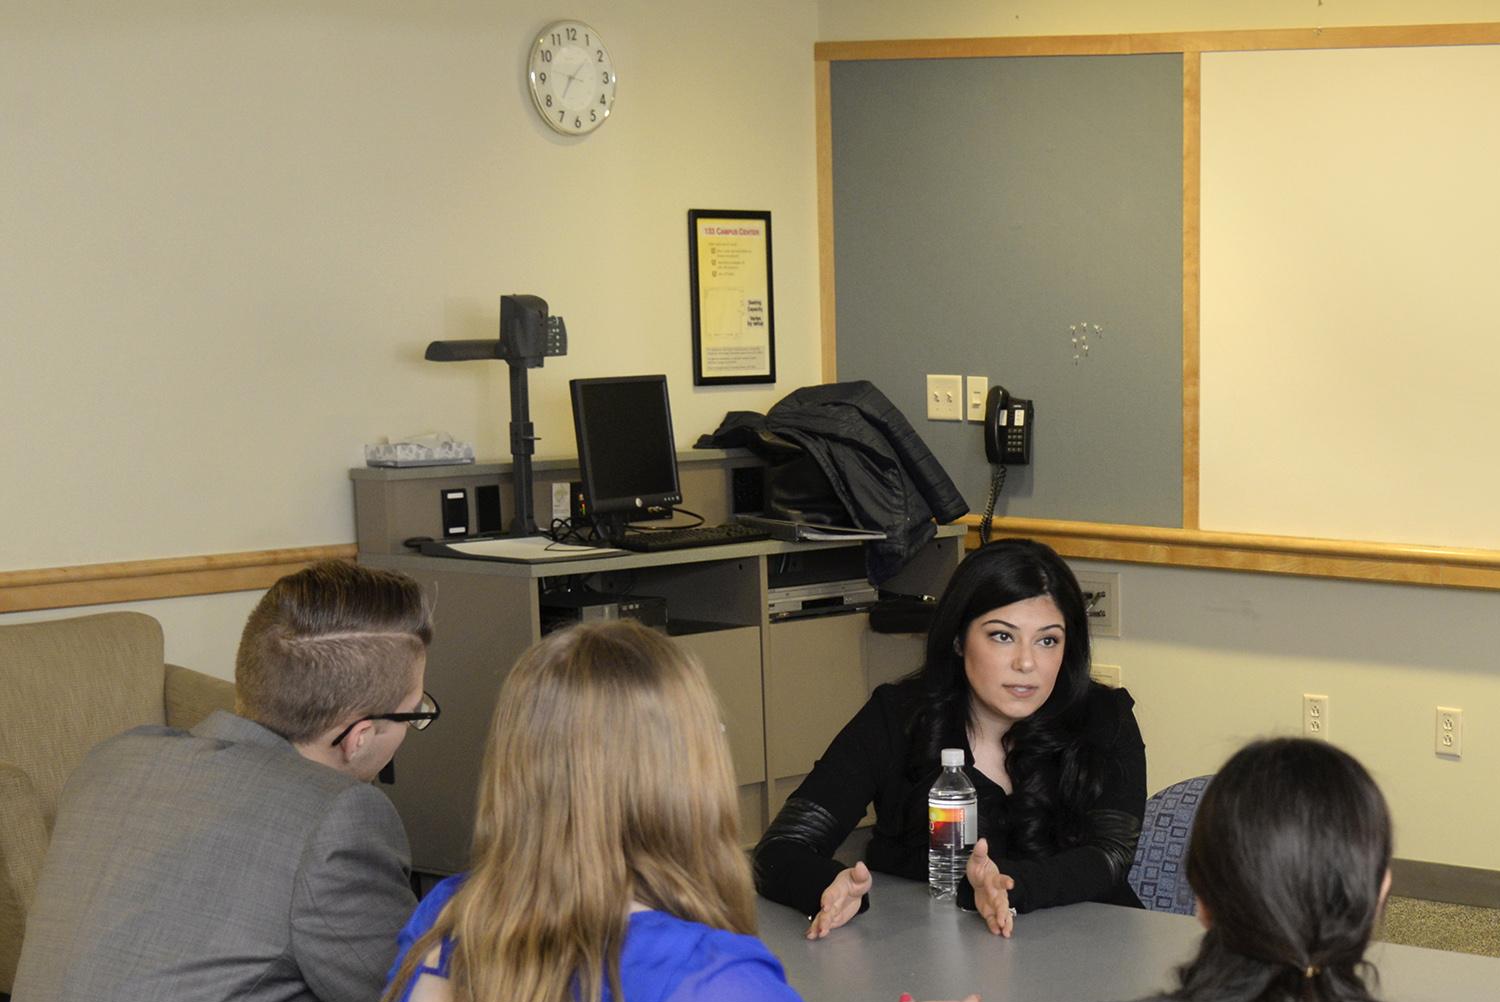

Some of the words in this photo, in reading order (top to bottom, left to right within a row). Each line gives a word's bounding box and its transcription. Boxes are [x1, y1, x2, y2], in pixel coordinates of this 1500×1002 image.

[551, 34, 561, 46] 11
[566, 28, 577, 41] 12
[585, 34, 590, 46] 1
[540, 50, 552, 62] 10
[597, 50, 604, 62] 2
[539, 72, 547, 85] 9
[602, 71, 610, 84] 3
[545, 94, 553, 107] 8
[599, 93, 606, 105] 4
[558, 110, 565, 123] 7
[574, 115, 582, 128] 6
[590, 109, 597, 122] 5
